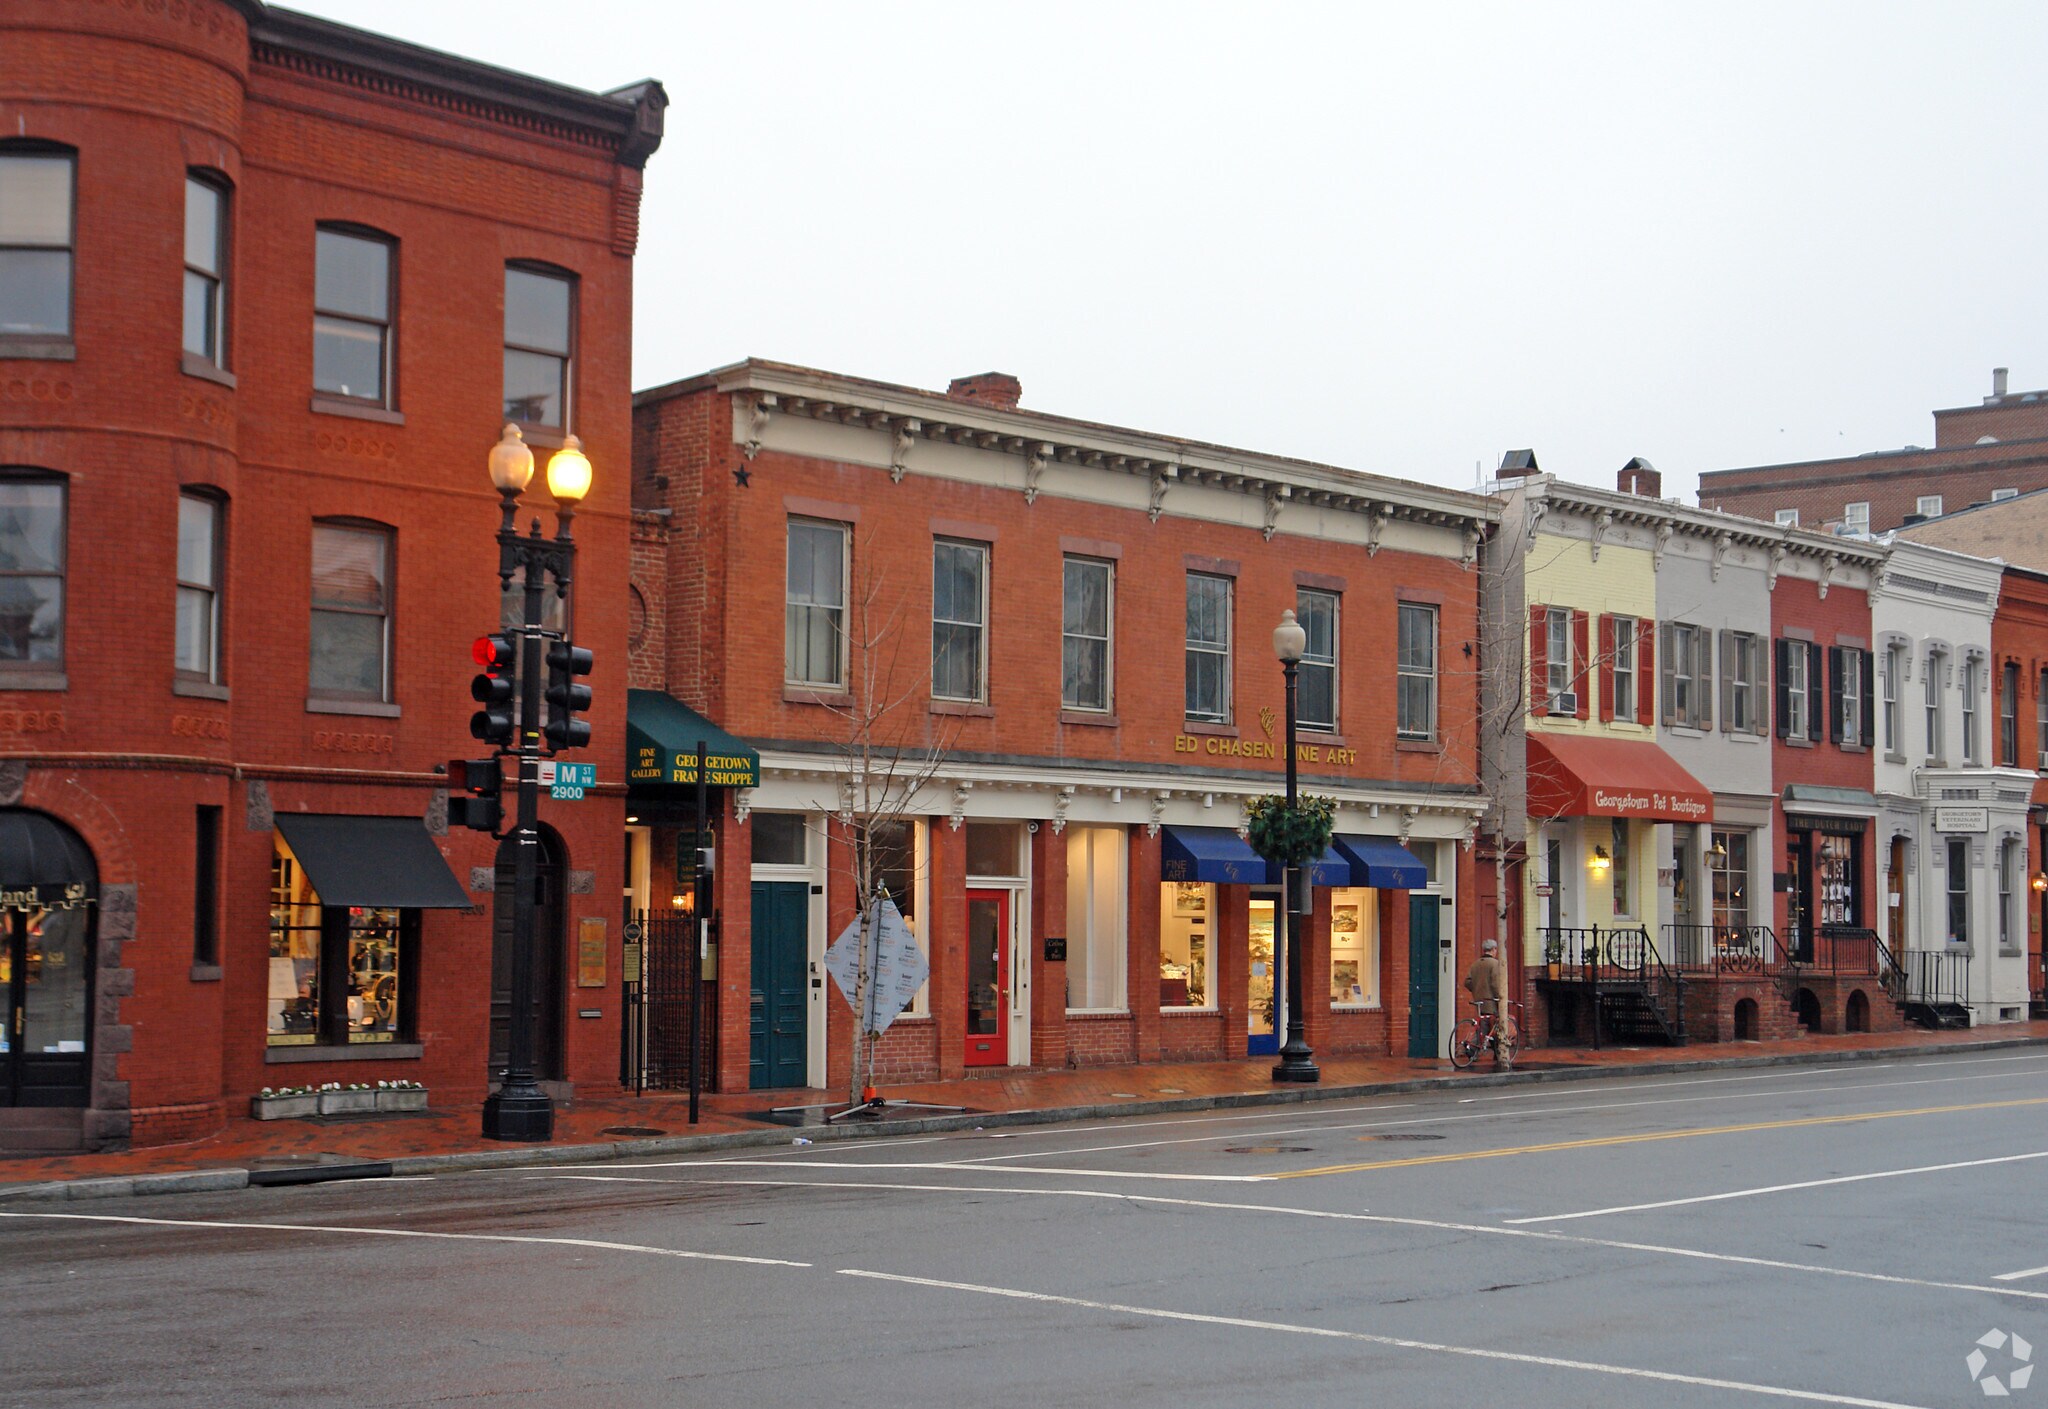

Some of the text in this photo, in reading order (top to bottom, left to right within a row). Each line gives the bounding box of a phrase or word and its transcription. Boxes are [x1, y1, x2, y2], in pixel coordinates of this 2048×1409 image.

[640, 748, 655, 757] FINE
[1175, 735, 1357, 765] ED CHASEN NE ART
[641, 758, 654, 767] ART
[675, 754, 751, 770] GEOGETOWN
[561, 765, 592, 783] M ST
[631, 769, 661, 778] GALLERY
[712, 772, 753, 785] SHOPPE
[581, 776, 592, 784] NW
[552, 786, 583, 799] 2900
[1595, 790, 1706, 818] Georgetown Pet Boutique
[1794, 818, 1809, 828] THE
[1814, 820, 1840, 830] DUTCH
[1166, 860, 1187, 870] FINE
[1168, 870, 1186, 880] ART
